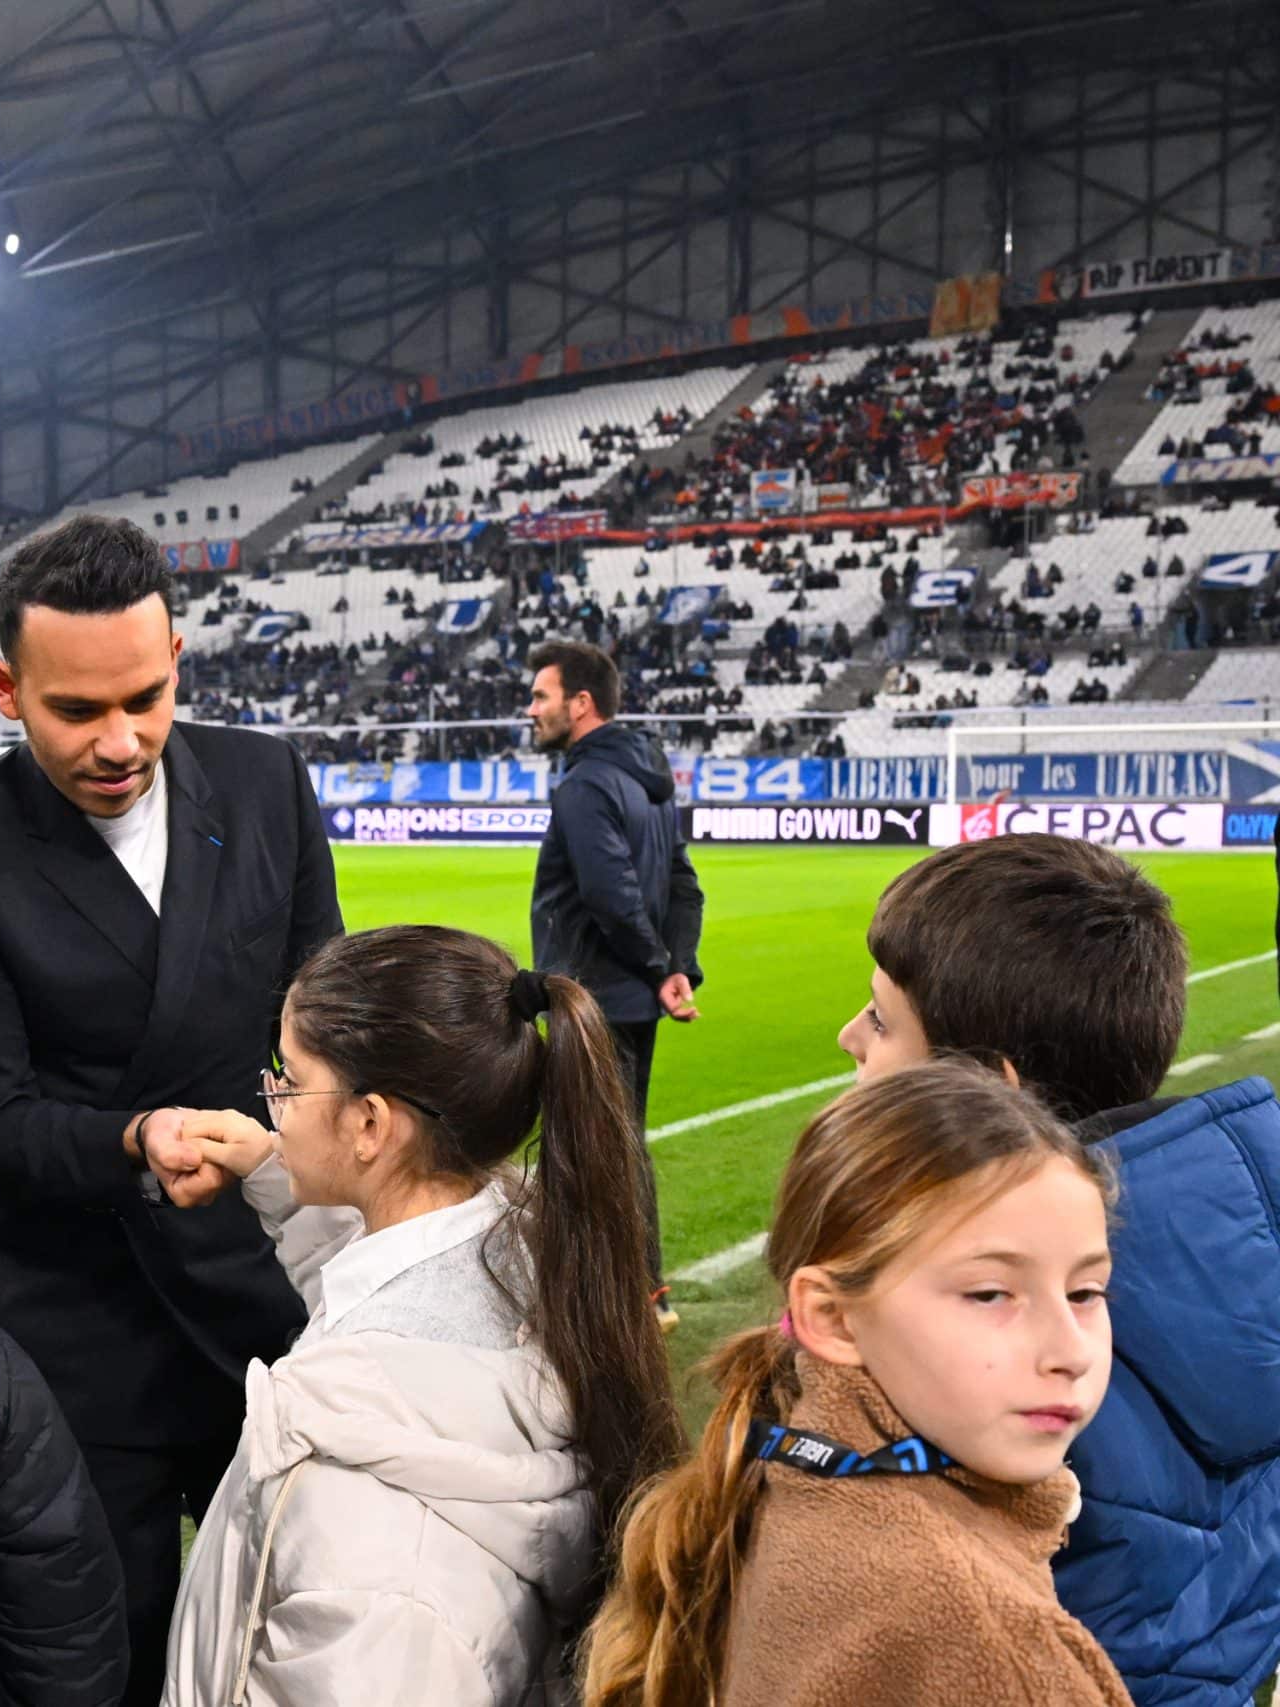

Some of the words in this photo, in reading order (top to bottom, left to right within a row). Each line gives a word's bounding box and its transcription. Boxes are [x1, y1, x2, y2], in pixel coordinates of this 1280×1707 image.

[697, 758, 805, 800] 84
[1042, 754, 1076, 790] les
[354, 807, 462, 832] PARIONS
[469, 812, 552, 828] SPOR
[1004, 807, 1187, 845] CEPAC
[1226, 813, 1277, 840] OLYM
